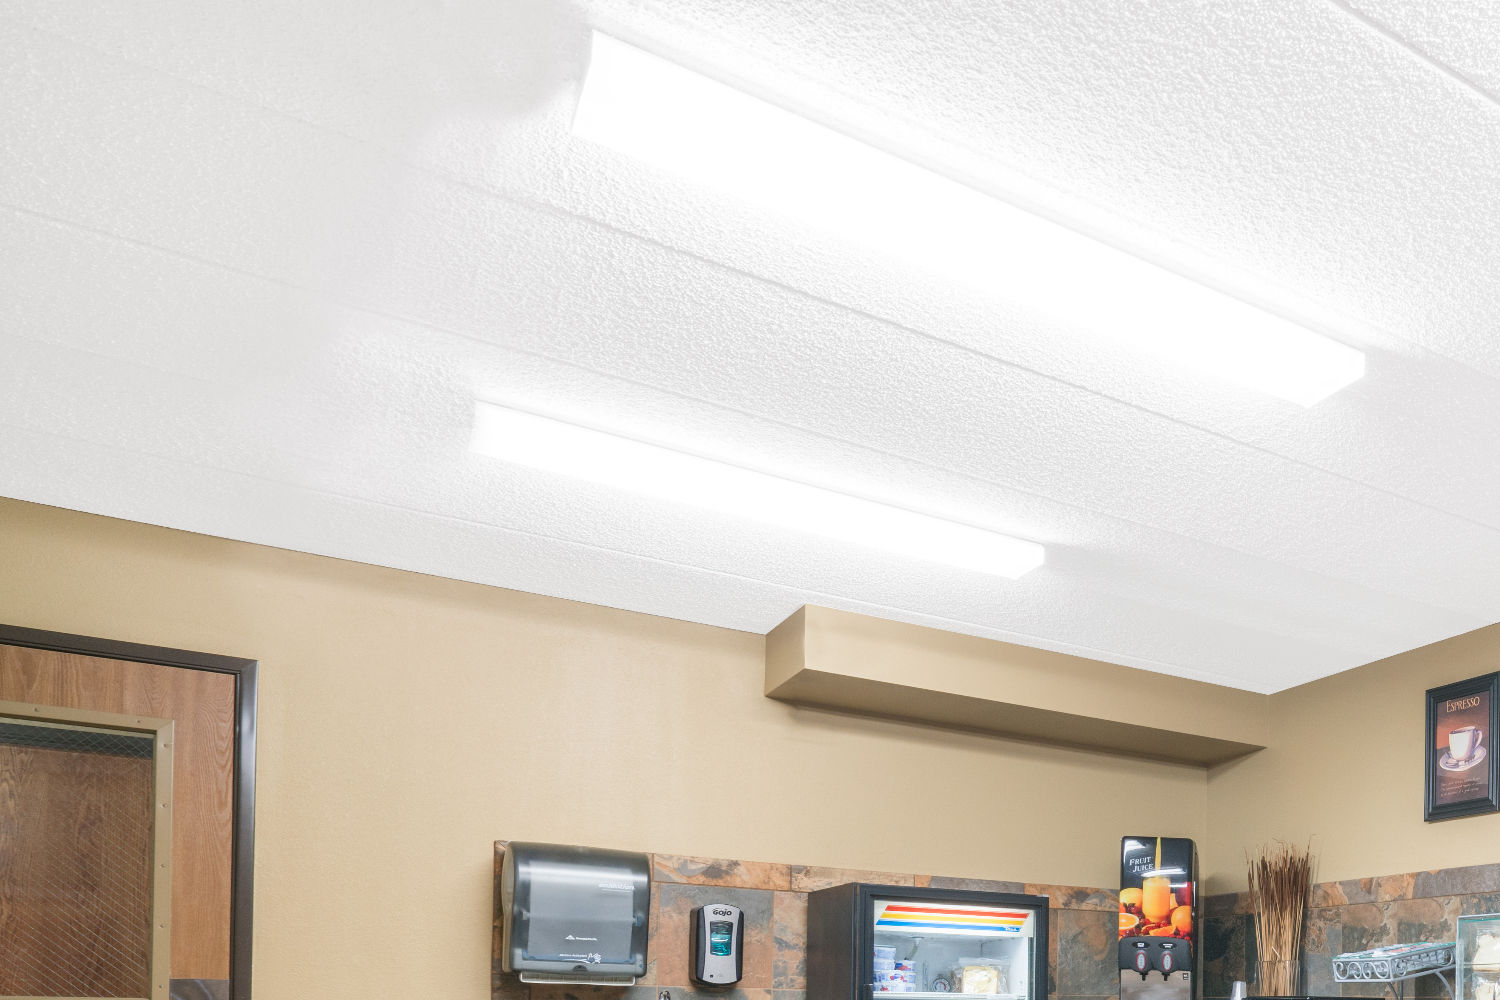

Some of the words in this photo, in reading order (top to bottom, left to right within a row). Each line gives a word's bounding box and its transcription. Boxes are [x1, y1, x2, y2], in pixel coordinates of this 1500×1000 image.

[1446, 696, 1480, 713] ESPRESSO
[1129, 856, 1152, 866] FRUIT
[1132, 863, 1154, 873] JUICE
[712, 908, 733, 917] GOJO
